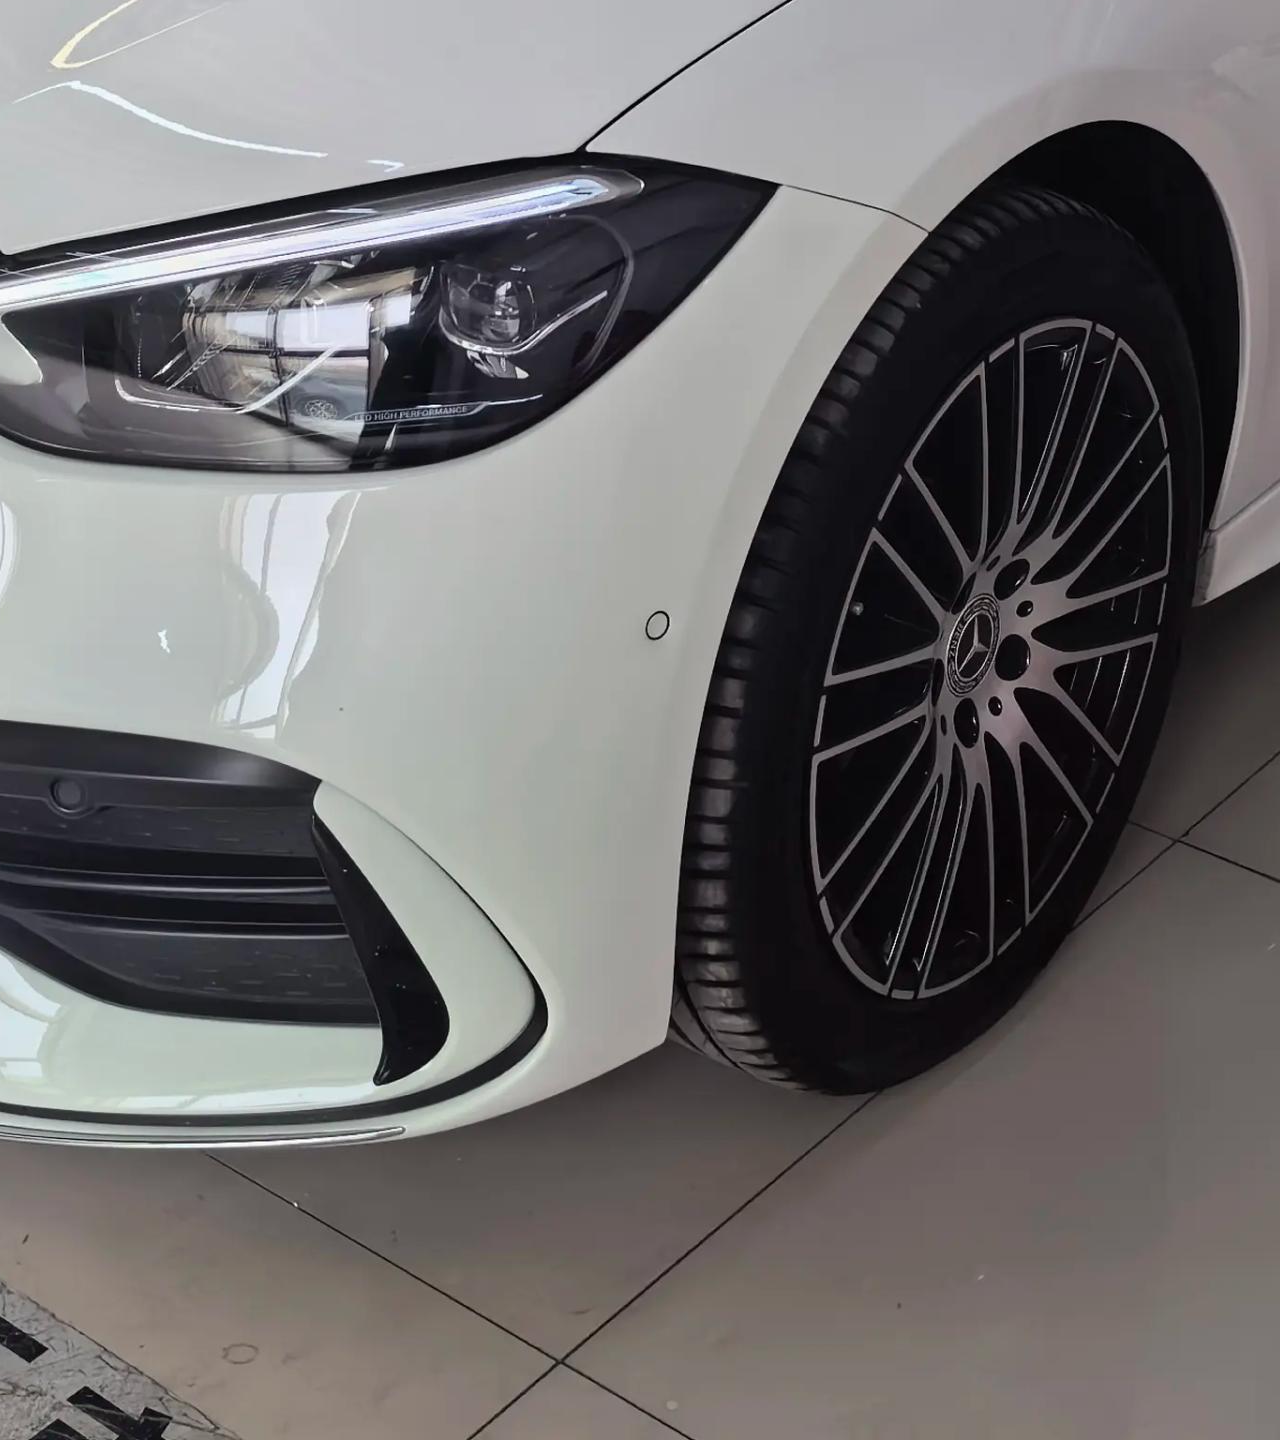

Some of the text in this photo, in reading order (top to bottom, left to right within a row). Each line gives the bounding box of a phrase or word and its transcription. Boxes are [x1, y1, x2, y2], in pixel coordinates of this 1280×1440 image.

[354, 405, 468, 422] LED HIGH PERFORMANCE
